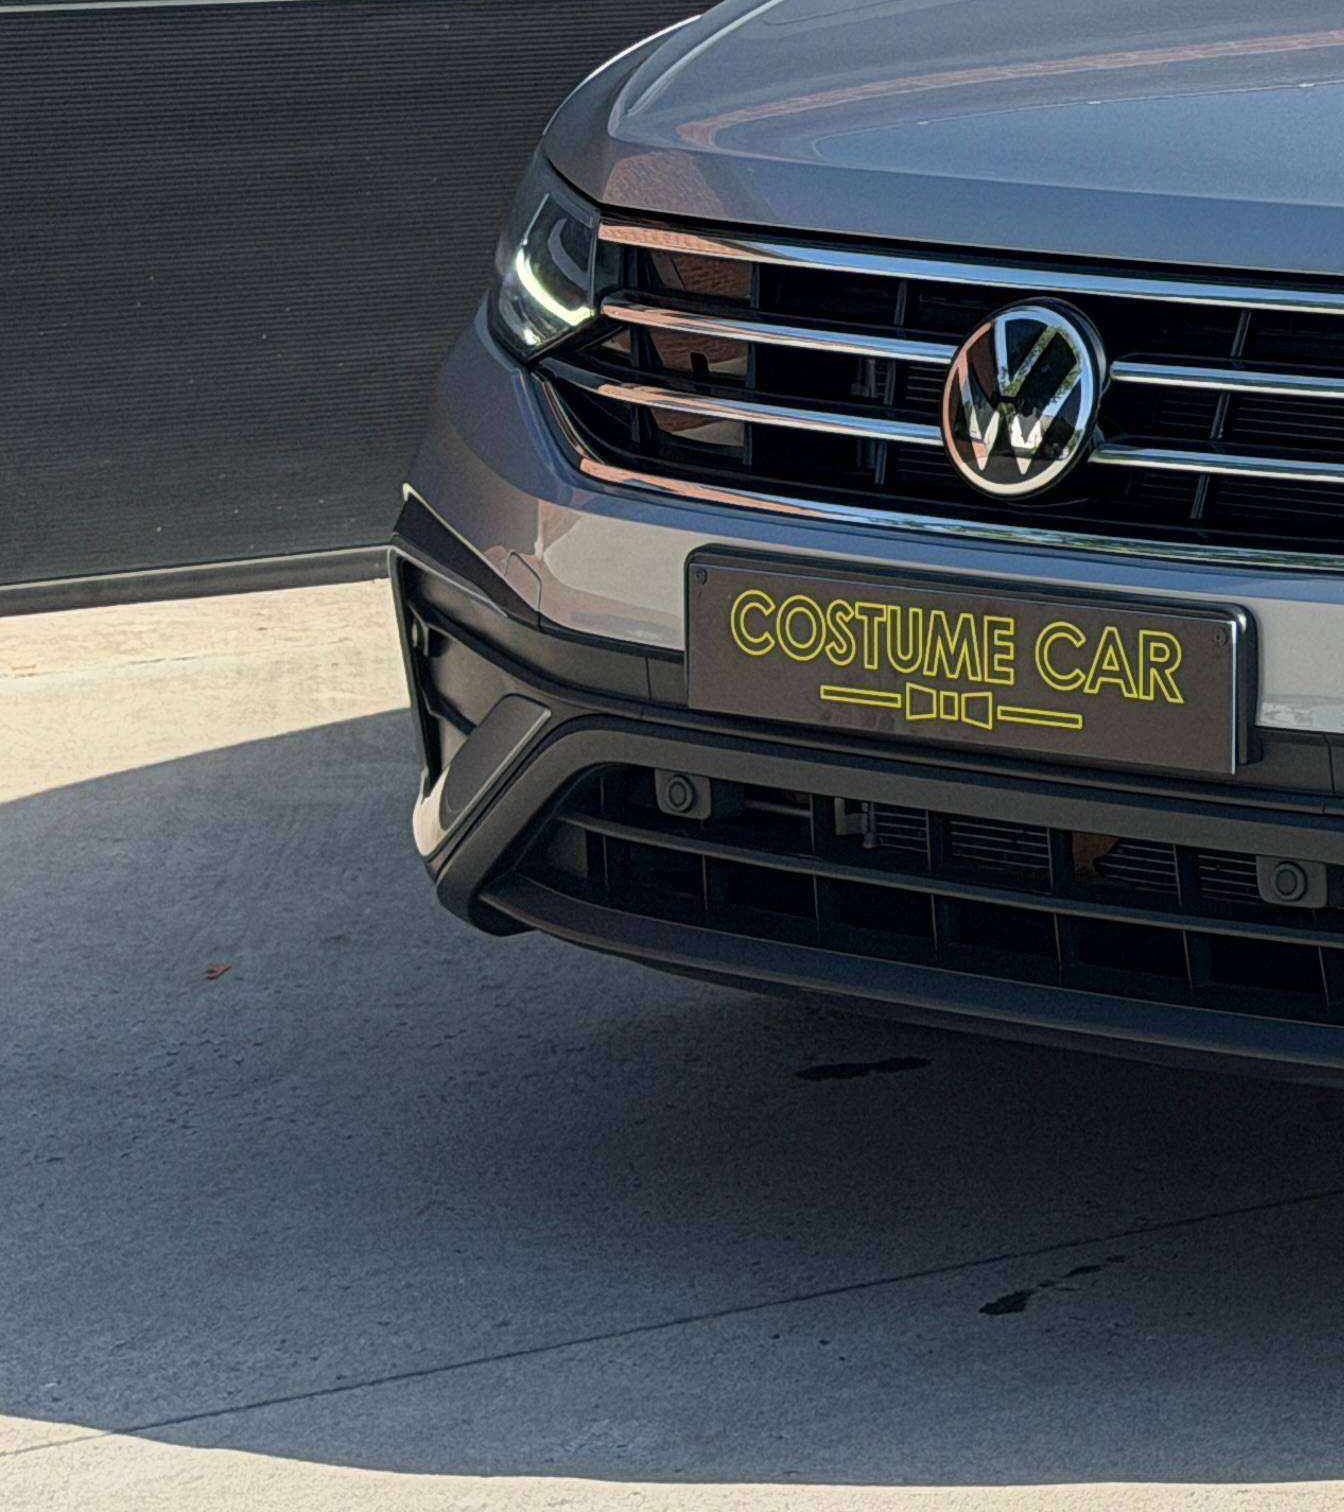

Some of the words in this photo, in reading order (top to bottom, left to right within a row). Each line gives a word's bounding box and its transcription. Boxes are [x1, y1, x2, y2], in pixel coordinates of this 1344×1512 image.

[943, 304, 1094, 495] VW
[731, 589, 1014, 685] COSTUME
[1035, 620, 1184, 704] CAR
